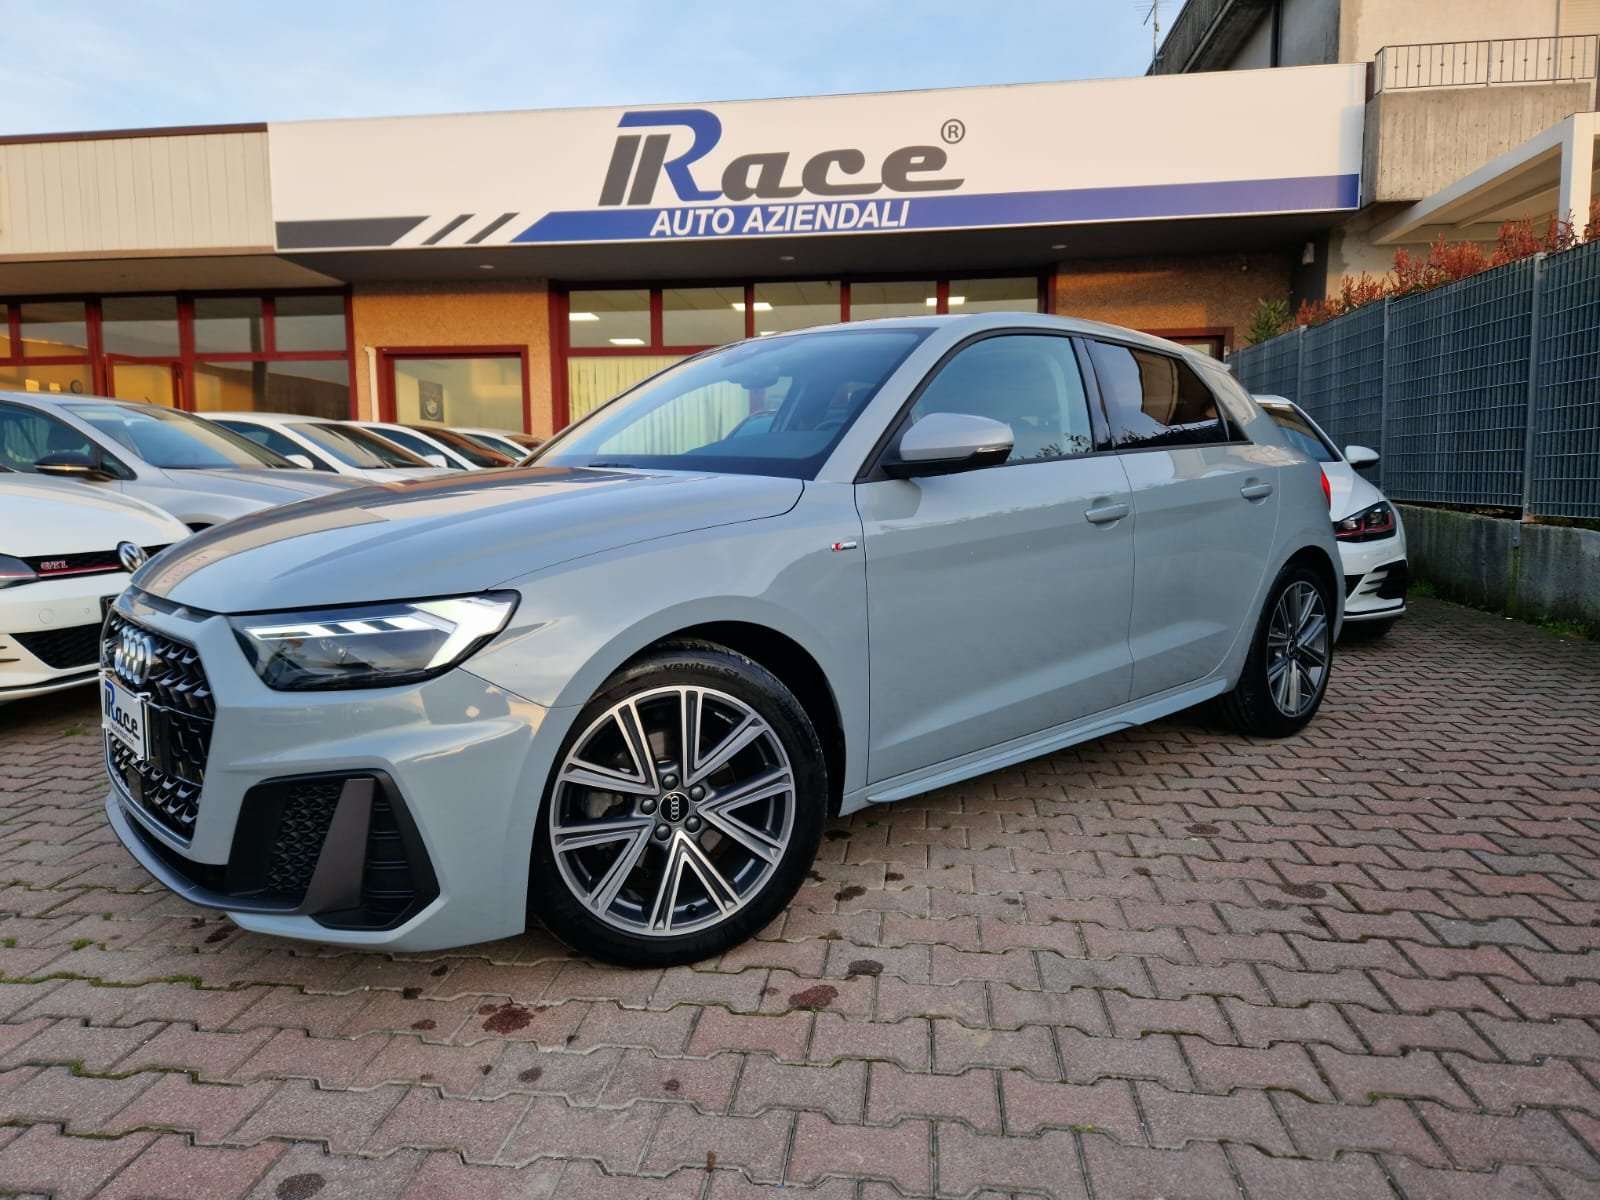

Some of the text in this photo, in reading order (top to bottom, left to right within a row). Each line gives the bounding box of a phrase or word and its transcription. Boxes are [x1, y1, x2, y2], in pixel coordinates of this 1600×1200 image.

[598, 109, 965, 206] Race
[650, 200, 911, 236] AUTO AZIENDALI
